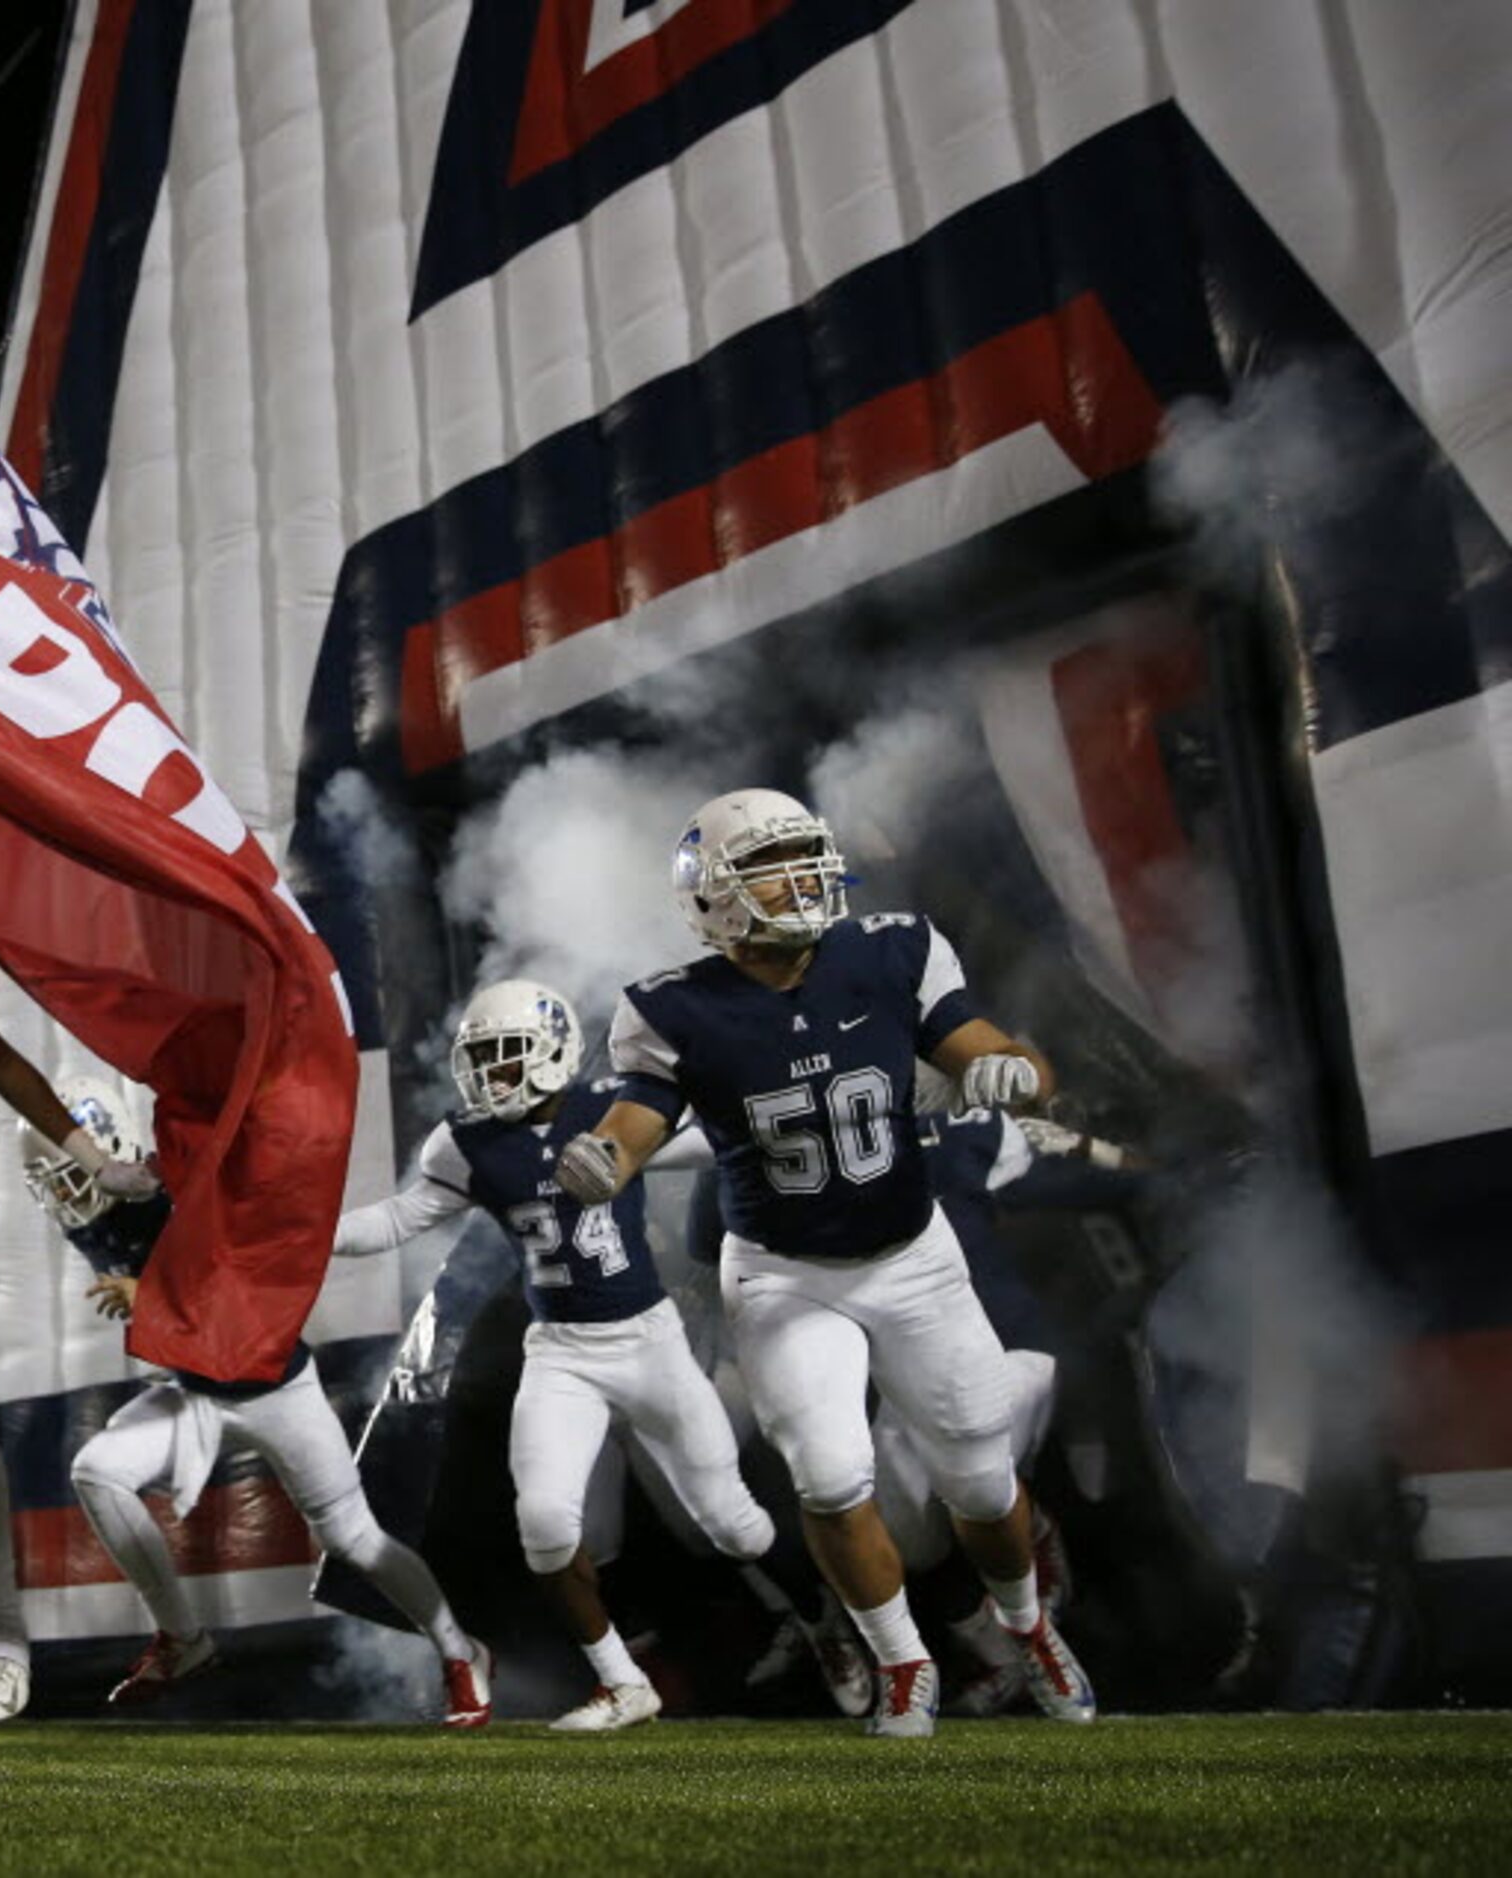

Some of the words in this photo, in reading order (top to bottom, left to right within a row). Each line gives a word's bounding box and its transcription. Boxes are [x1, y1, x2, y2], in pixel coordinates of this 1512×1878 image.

[790, 1052, 832, 1079] ALLEN
[743, 1065, 895, 1194] 50
[506, 1198, 630, 1287] 24
